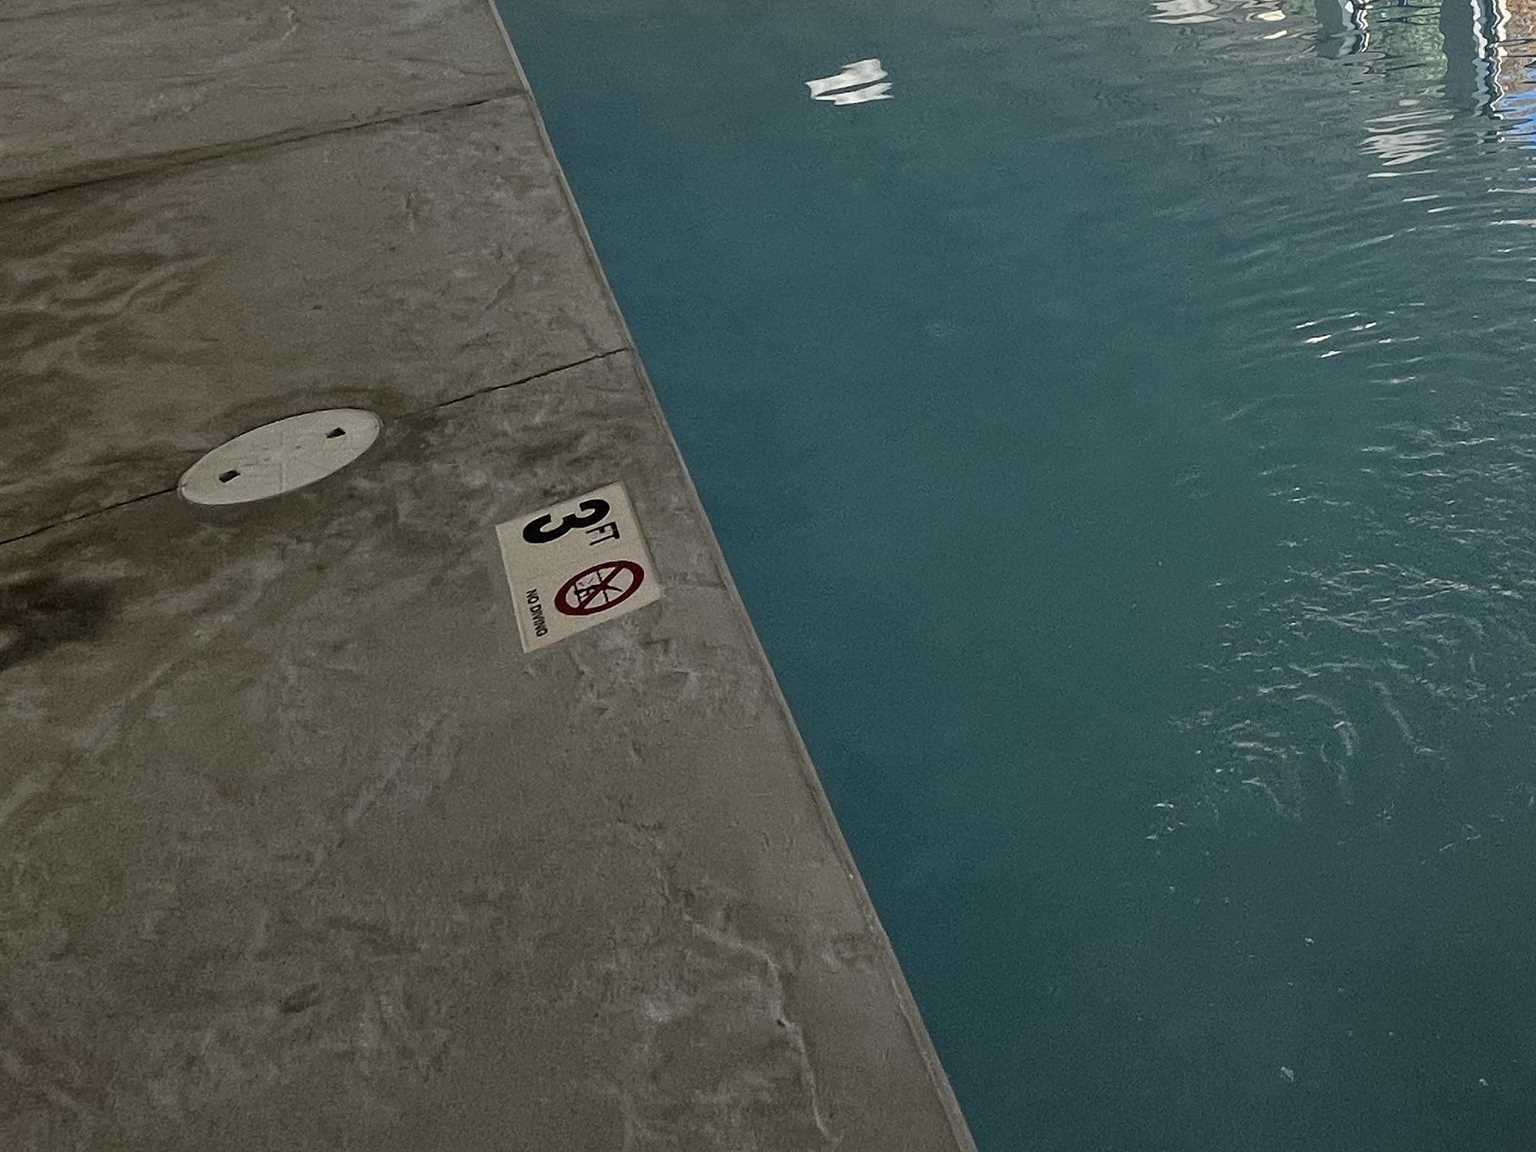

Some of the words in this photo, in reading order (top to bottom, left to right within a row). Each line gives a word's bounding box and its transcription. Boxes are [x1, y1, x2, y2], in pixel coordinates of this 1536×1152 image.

[523, 499, 610, 544] 3
[586, 521, 621, 546] FT
[526, 589, 538, 605] NO
[530, 605, 548, 637] DIVING
